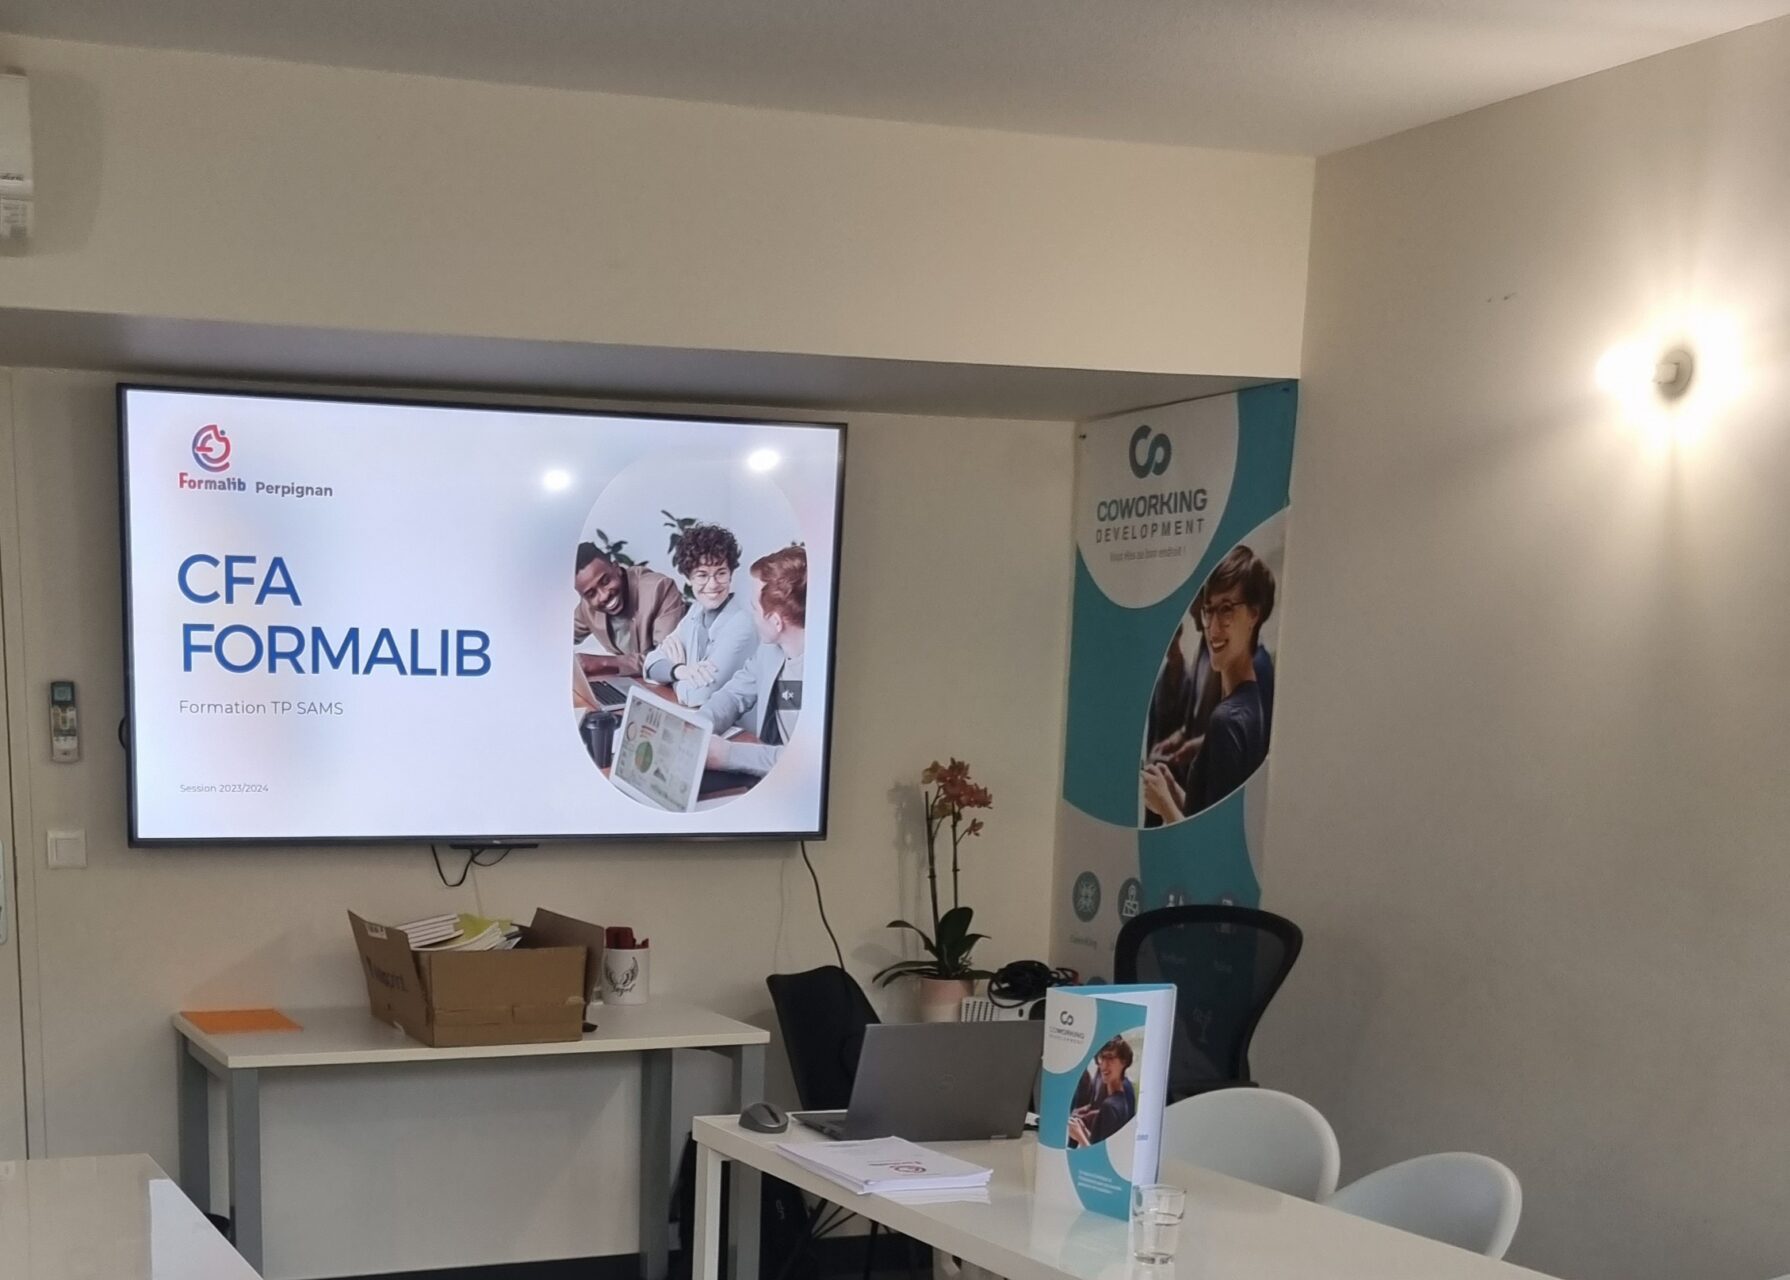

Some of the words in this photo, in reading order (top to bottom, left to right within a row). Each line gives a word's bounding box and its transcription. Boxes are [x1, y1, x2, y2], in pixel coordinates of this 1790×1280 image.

[178, 472, 247, 493] Formalib
[255, 481, 333, 499] Perpignan
[1097, 488, 1208, 522] COWORKING
[1096, 518, 1206, 543] DEVELOPMENT
[177, 553, 302, 606] CFA
[182, 622, 492, 677] FORMALIB
[179, 699, 267, 715] Formation
[271, 700, 293, 715] TP
[296, 701, 344, 716] SAMS
[179, 784, 217, 793] Session
[219, 783, 269, 795] 2023/2024
